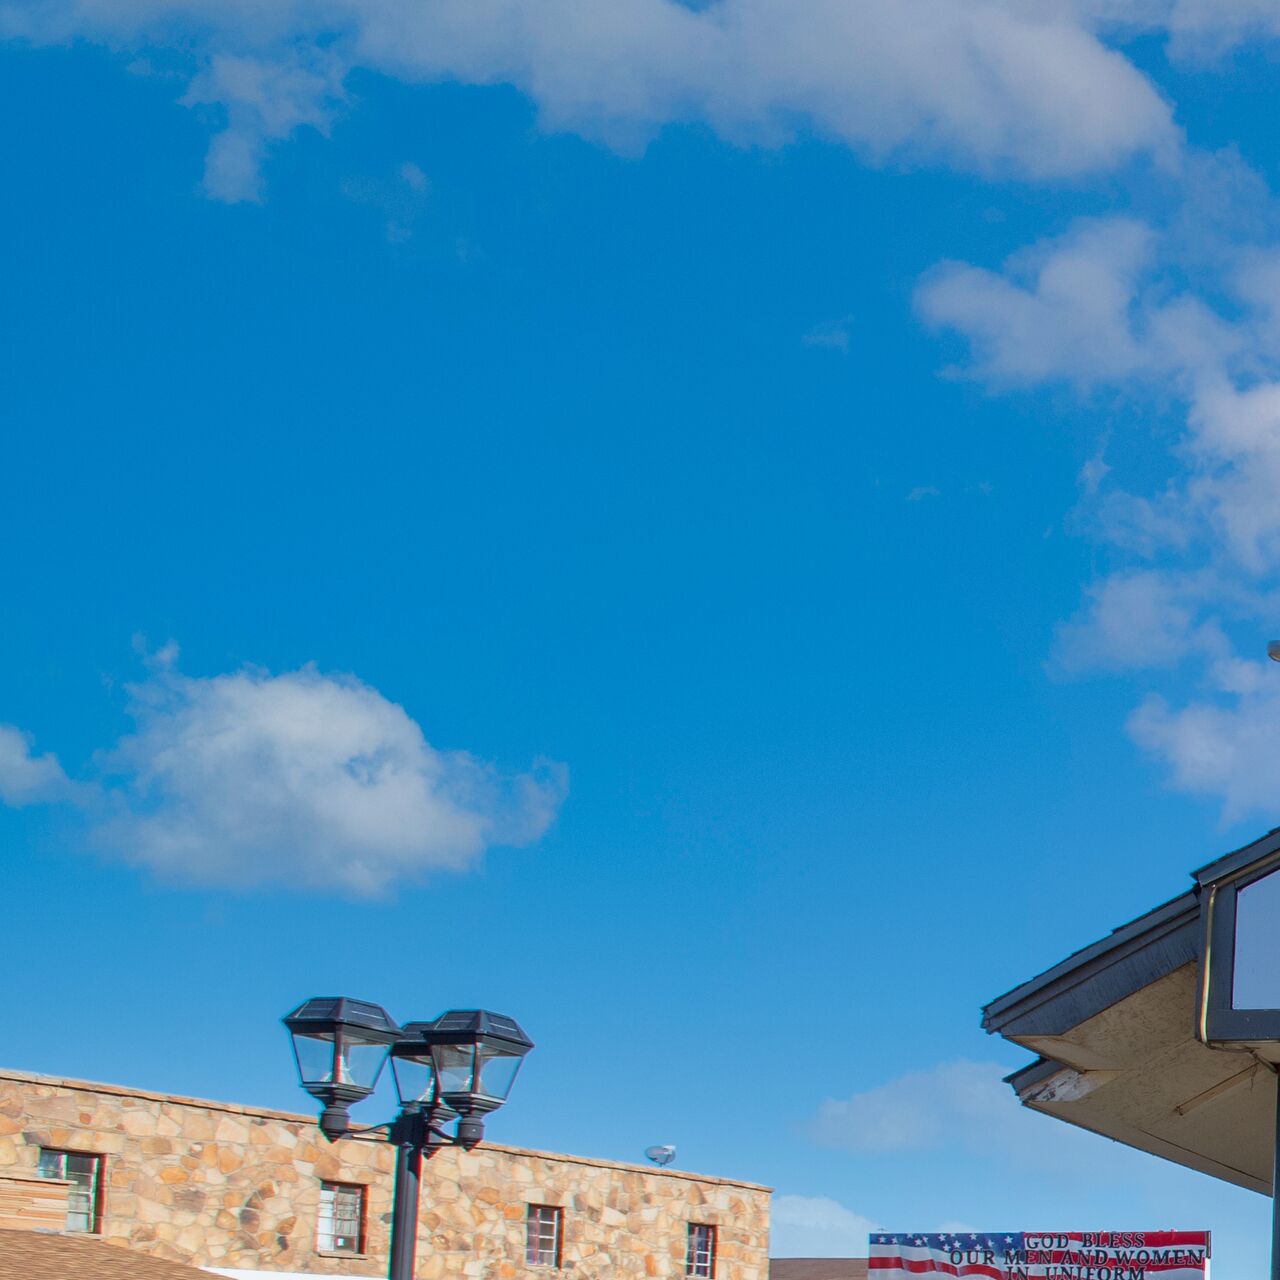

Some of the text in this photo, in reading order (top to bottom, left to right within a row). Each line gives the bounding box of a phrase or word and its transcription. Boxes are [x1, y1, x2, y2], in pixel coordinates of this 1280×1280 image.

[1026, 1232, 1145, 1249] GOD BLESS
[950, 1248, 1204, 1266] OUR MEN AND WOMEN
[1007, 1266, 1029, 1280] IN
